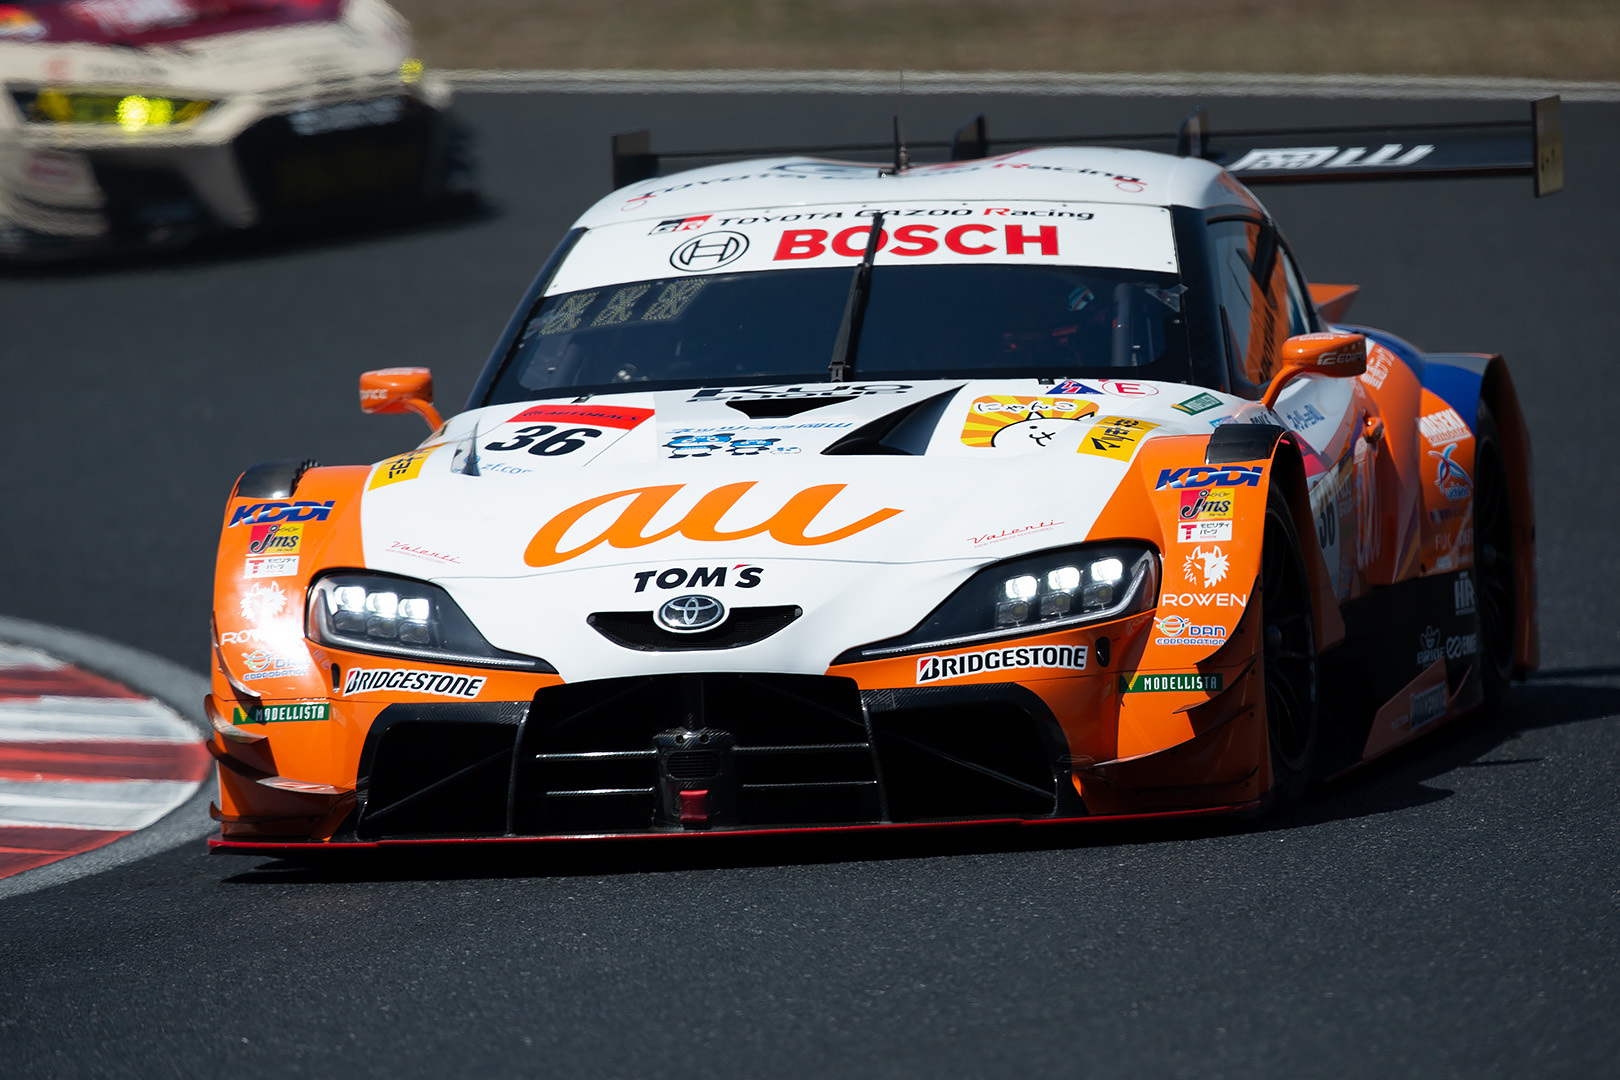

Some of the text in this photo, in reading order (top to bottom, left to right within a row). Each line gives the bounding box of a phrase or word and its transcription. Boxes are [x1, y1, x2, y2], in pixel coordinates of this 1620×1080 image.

[719, 207, 1095, 226] TOYOTA GAZOO Racing
[773, 223, 1060, 261] BOSCH
[484, 425, 603, 457] 36
[1155, 466, 1263, 491] KDDI
[227, 500, 336, 528] KDDI
[1181, 489, 1231, 519] jms
[523, 480, 905, 568] au
[966, 519, 1065, 544] Valenti
[250, 524, 299, 553] jms
[390, 541, 461, 565] Valenti
[633, 564, 764, 594] TOM'S
[1162, 593, 1247, 607] ROWEN
[1155, 638, 1227, 646] CORPORATION
[1188, 624, 1227, 637] DAN
[919, 647, 1086, 682] BRIDGESTONE
[344, 669, 483, 698] BRIDGESTONE
[1144, 676, 1217, 690] MODELLISTA
[256, 705, 325, 721] MODELLISTA
